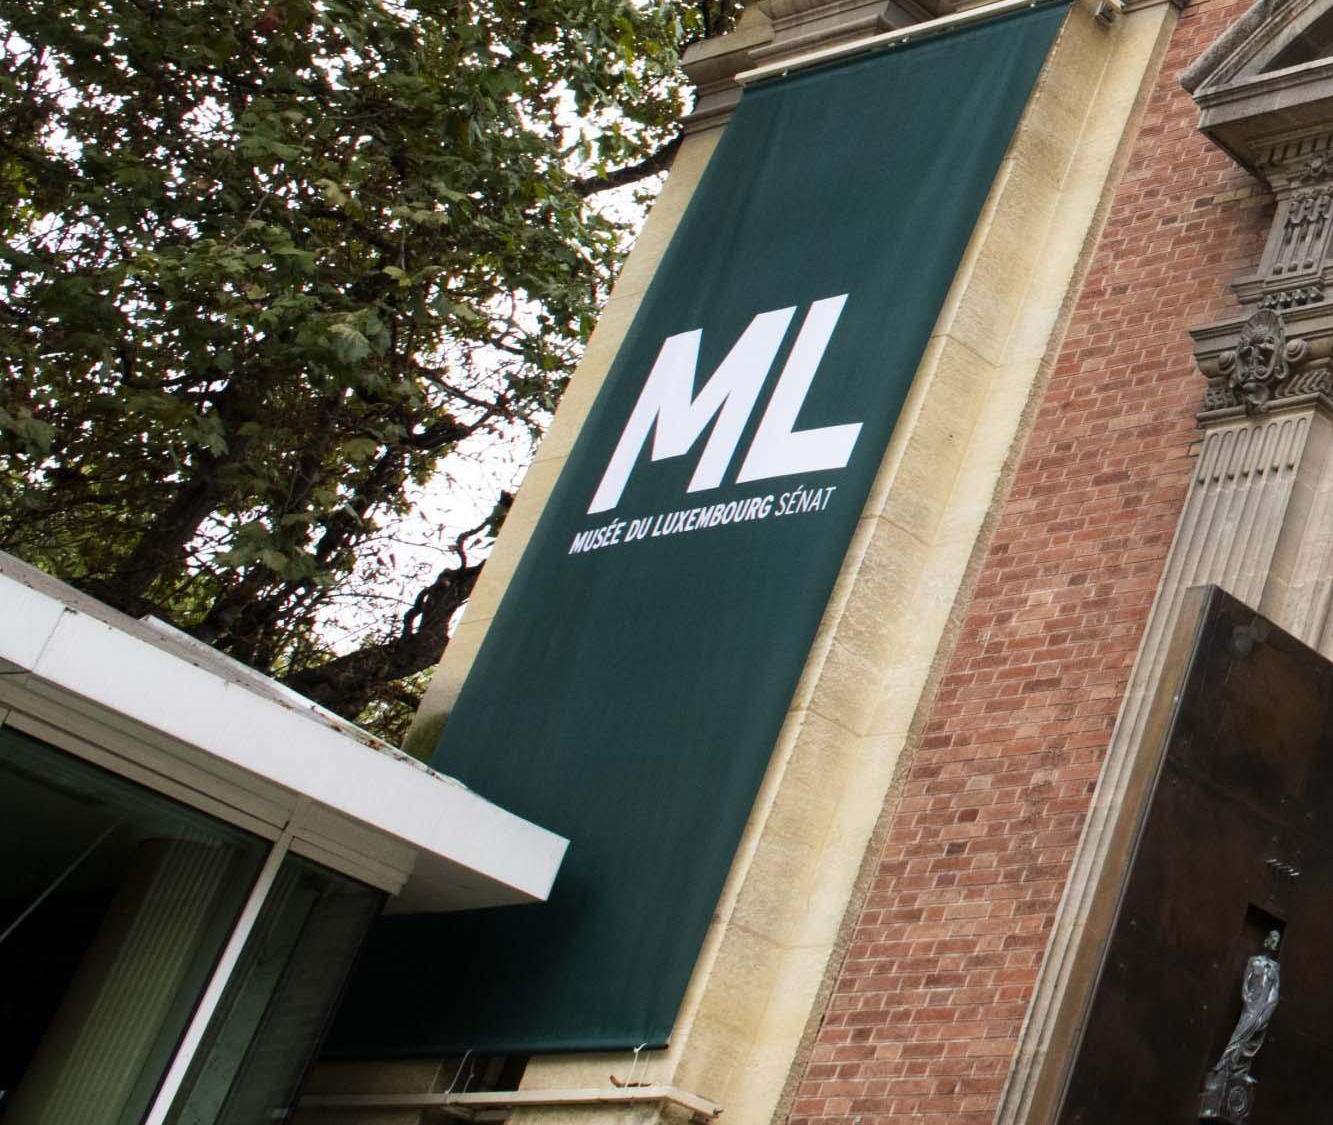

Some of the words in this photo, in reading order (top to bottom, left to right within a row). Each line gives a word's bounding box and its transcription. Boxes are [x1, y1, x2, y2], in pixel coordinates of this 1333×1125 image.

[586, 292, 864, 515] ML
[568, 518, 627, 555] MUSÉE
[624, 519, 656, 543] DU
[651, 495, 776, 537] LUXEMBOURG
[774, 485, 837, 516] SÉNAT
